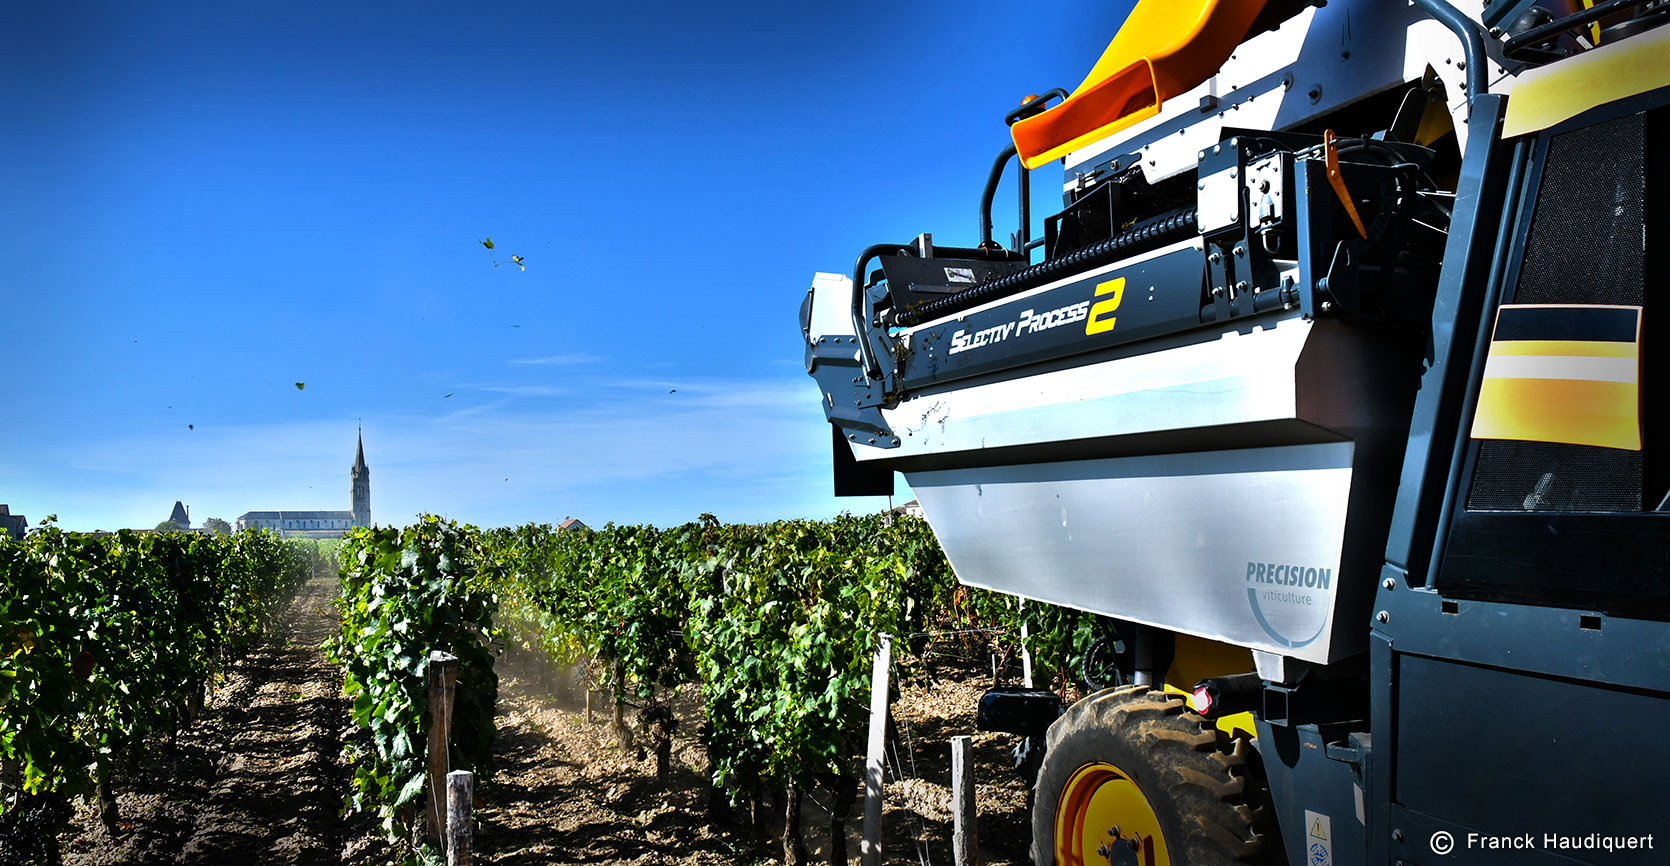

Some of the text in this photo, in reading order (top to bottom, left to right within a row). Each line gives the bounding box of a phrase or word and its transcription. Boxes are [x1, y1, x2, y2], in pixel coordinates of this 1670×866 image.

[1085, 276, 1126, 336] 2
[1246, 561, 1331, 590] PRECISION
[1261, 589, 1312, 606] viticulture
